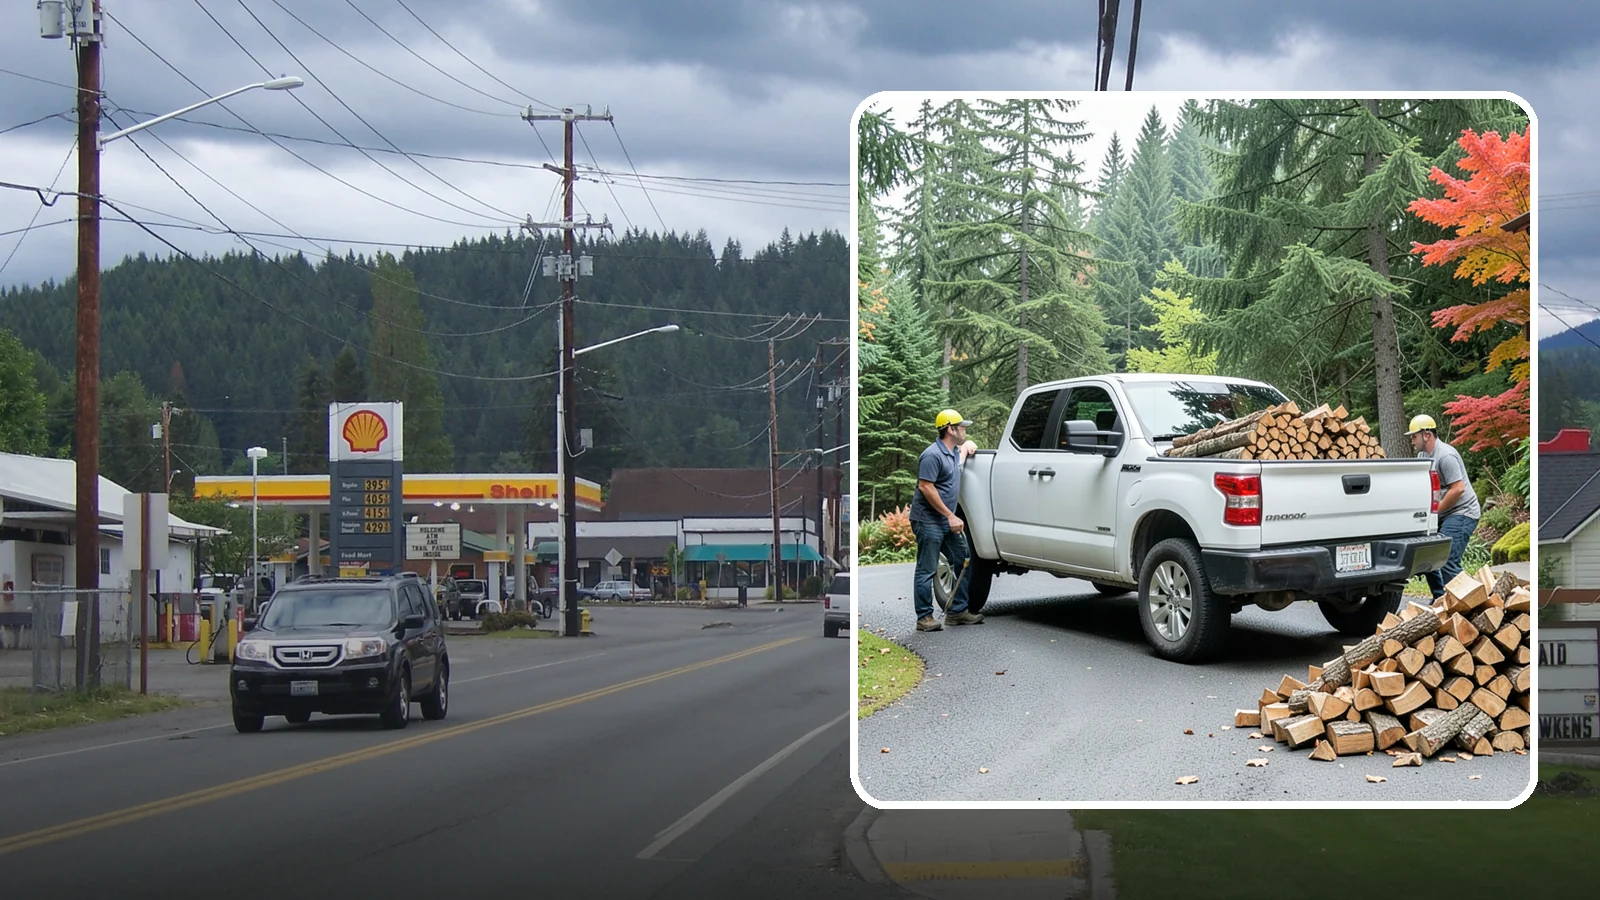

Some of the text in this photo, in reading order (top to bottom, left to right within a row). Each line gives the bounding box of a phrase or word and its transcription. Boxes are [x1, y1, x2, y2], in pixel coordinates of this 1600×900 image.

[366, 480, 384, 490] 395
[490, 484, 547, 499] Shell
[365, 494, 384, 504] 405
[365, 508, 384, 518] 415
[365, 522, 384, 532] 429
